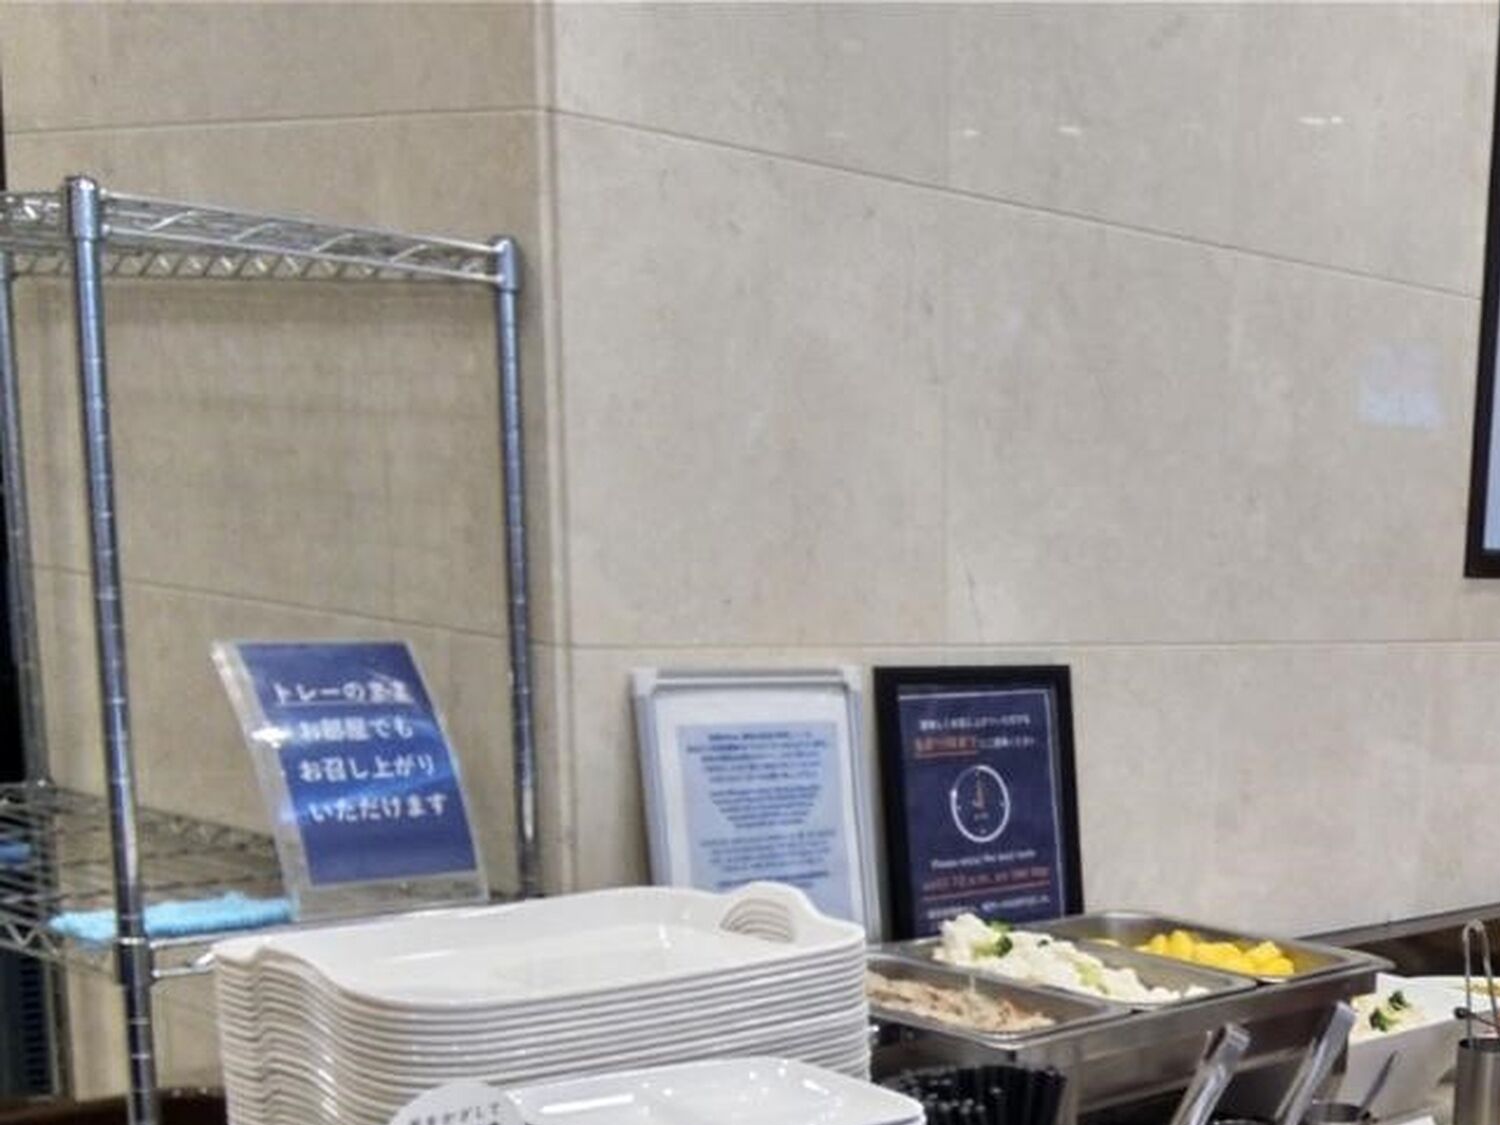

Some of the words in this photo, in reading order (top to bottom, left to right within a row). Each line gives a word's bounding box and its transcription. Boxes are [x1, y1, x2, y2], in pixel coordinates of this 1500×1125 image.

[298, 715, 414, 741] お部屋でも
[298, 755, 435, 782] お召し上がり
[307, 793, 448, 821] いただけます
